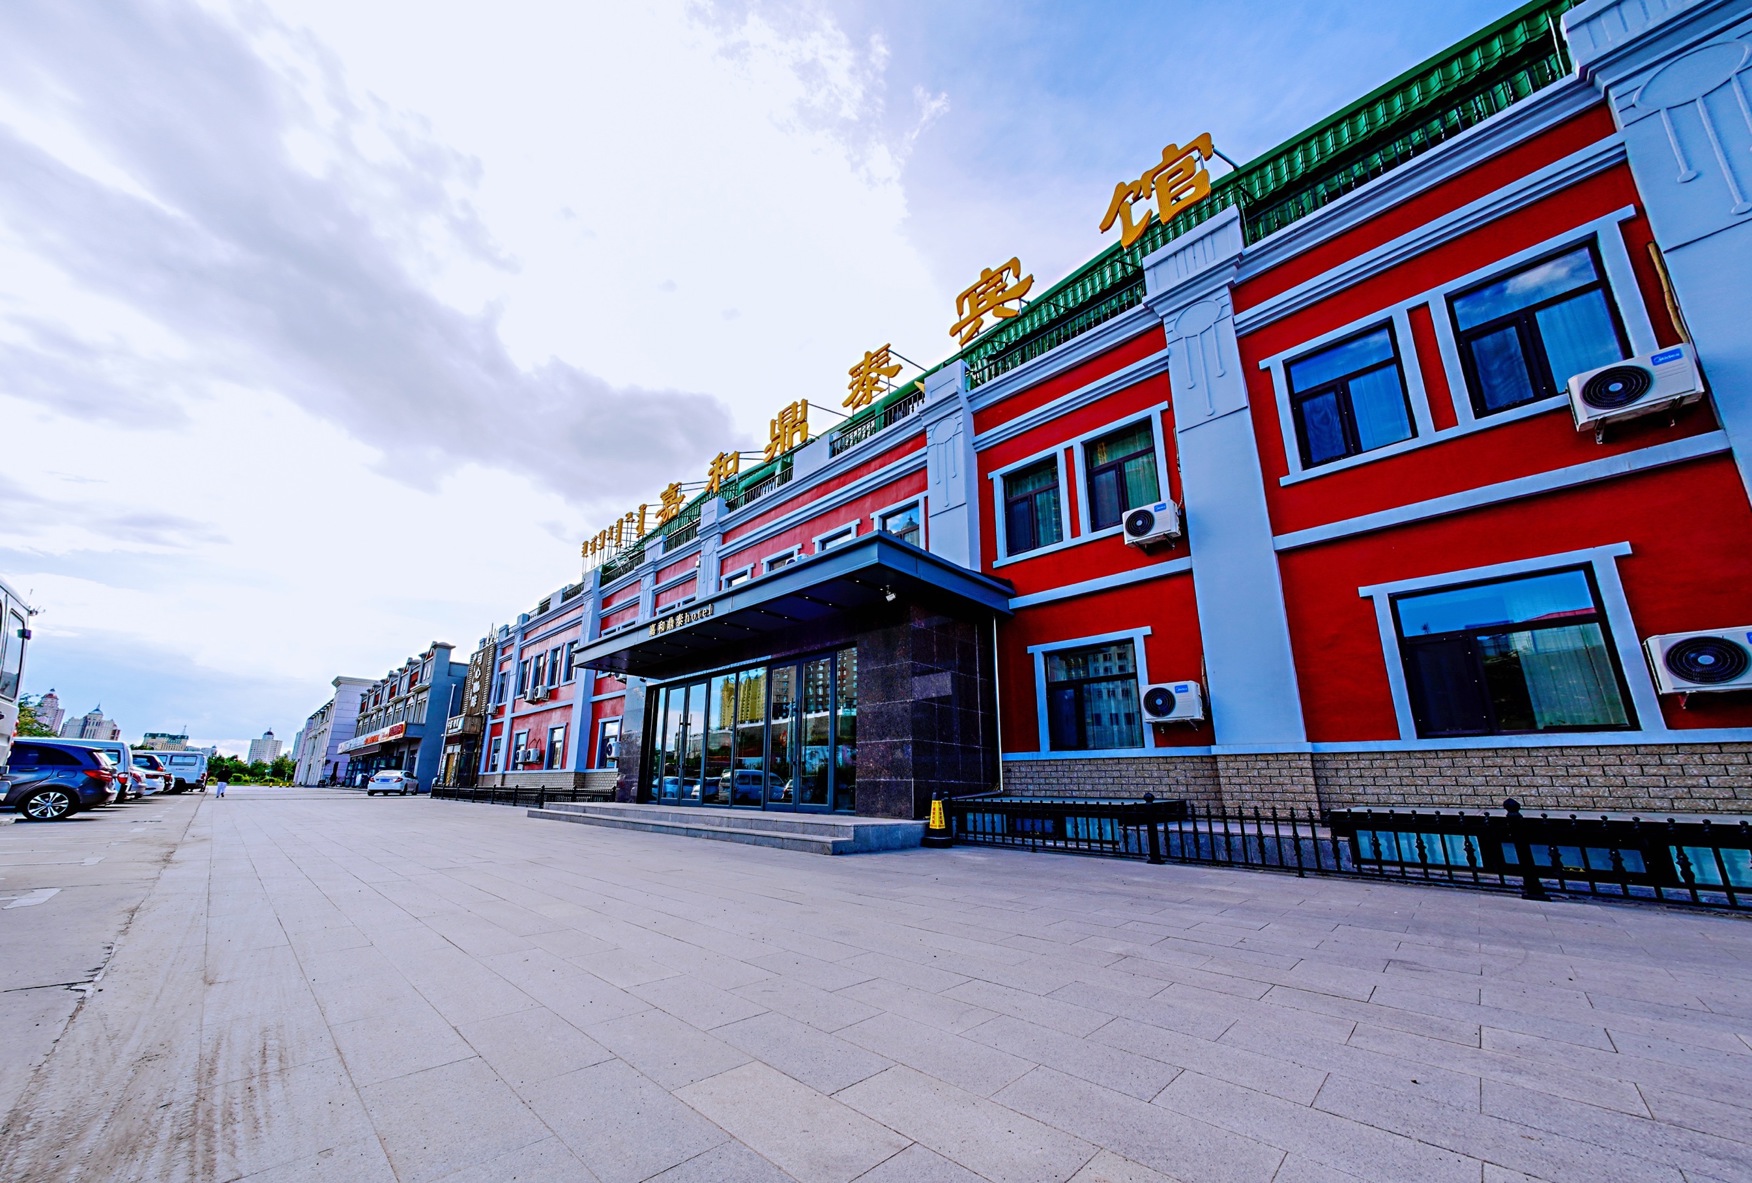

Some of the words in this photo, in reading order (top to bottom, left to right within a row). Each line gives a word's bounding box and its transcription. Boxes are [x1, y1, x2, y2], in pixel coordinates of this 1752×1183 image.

[655, 132, 1213, 526] 嘉和鼎泰宾馆
